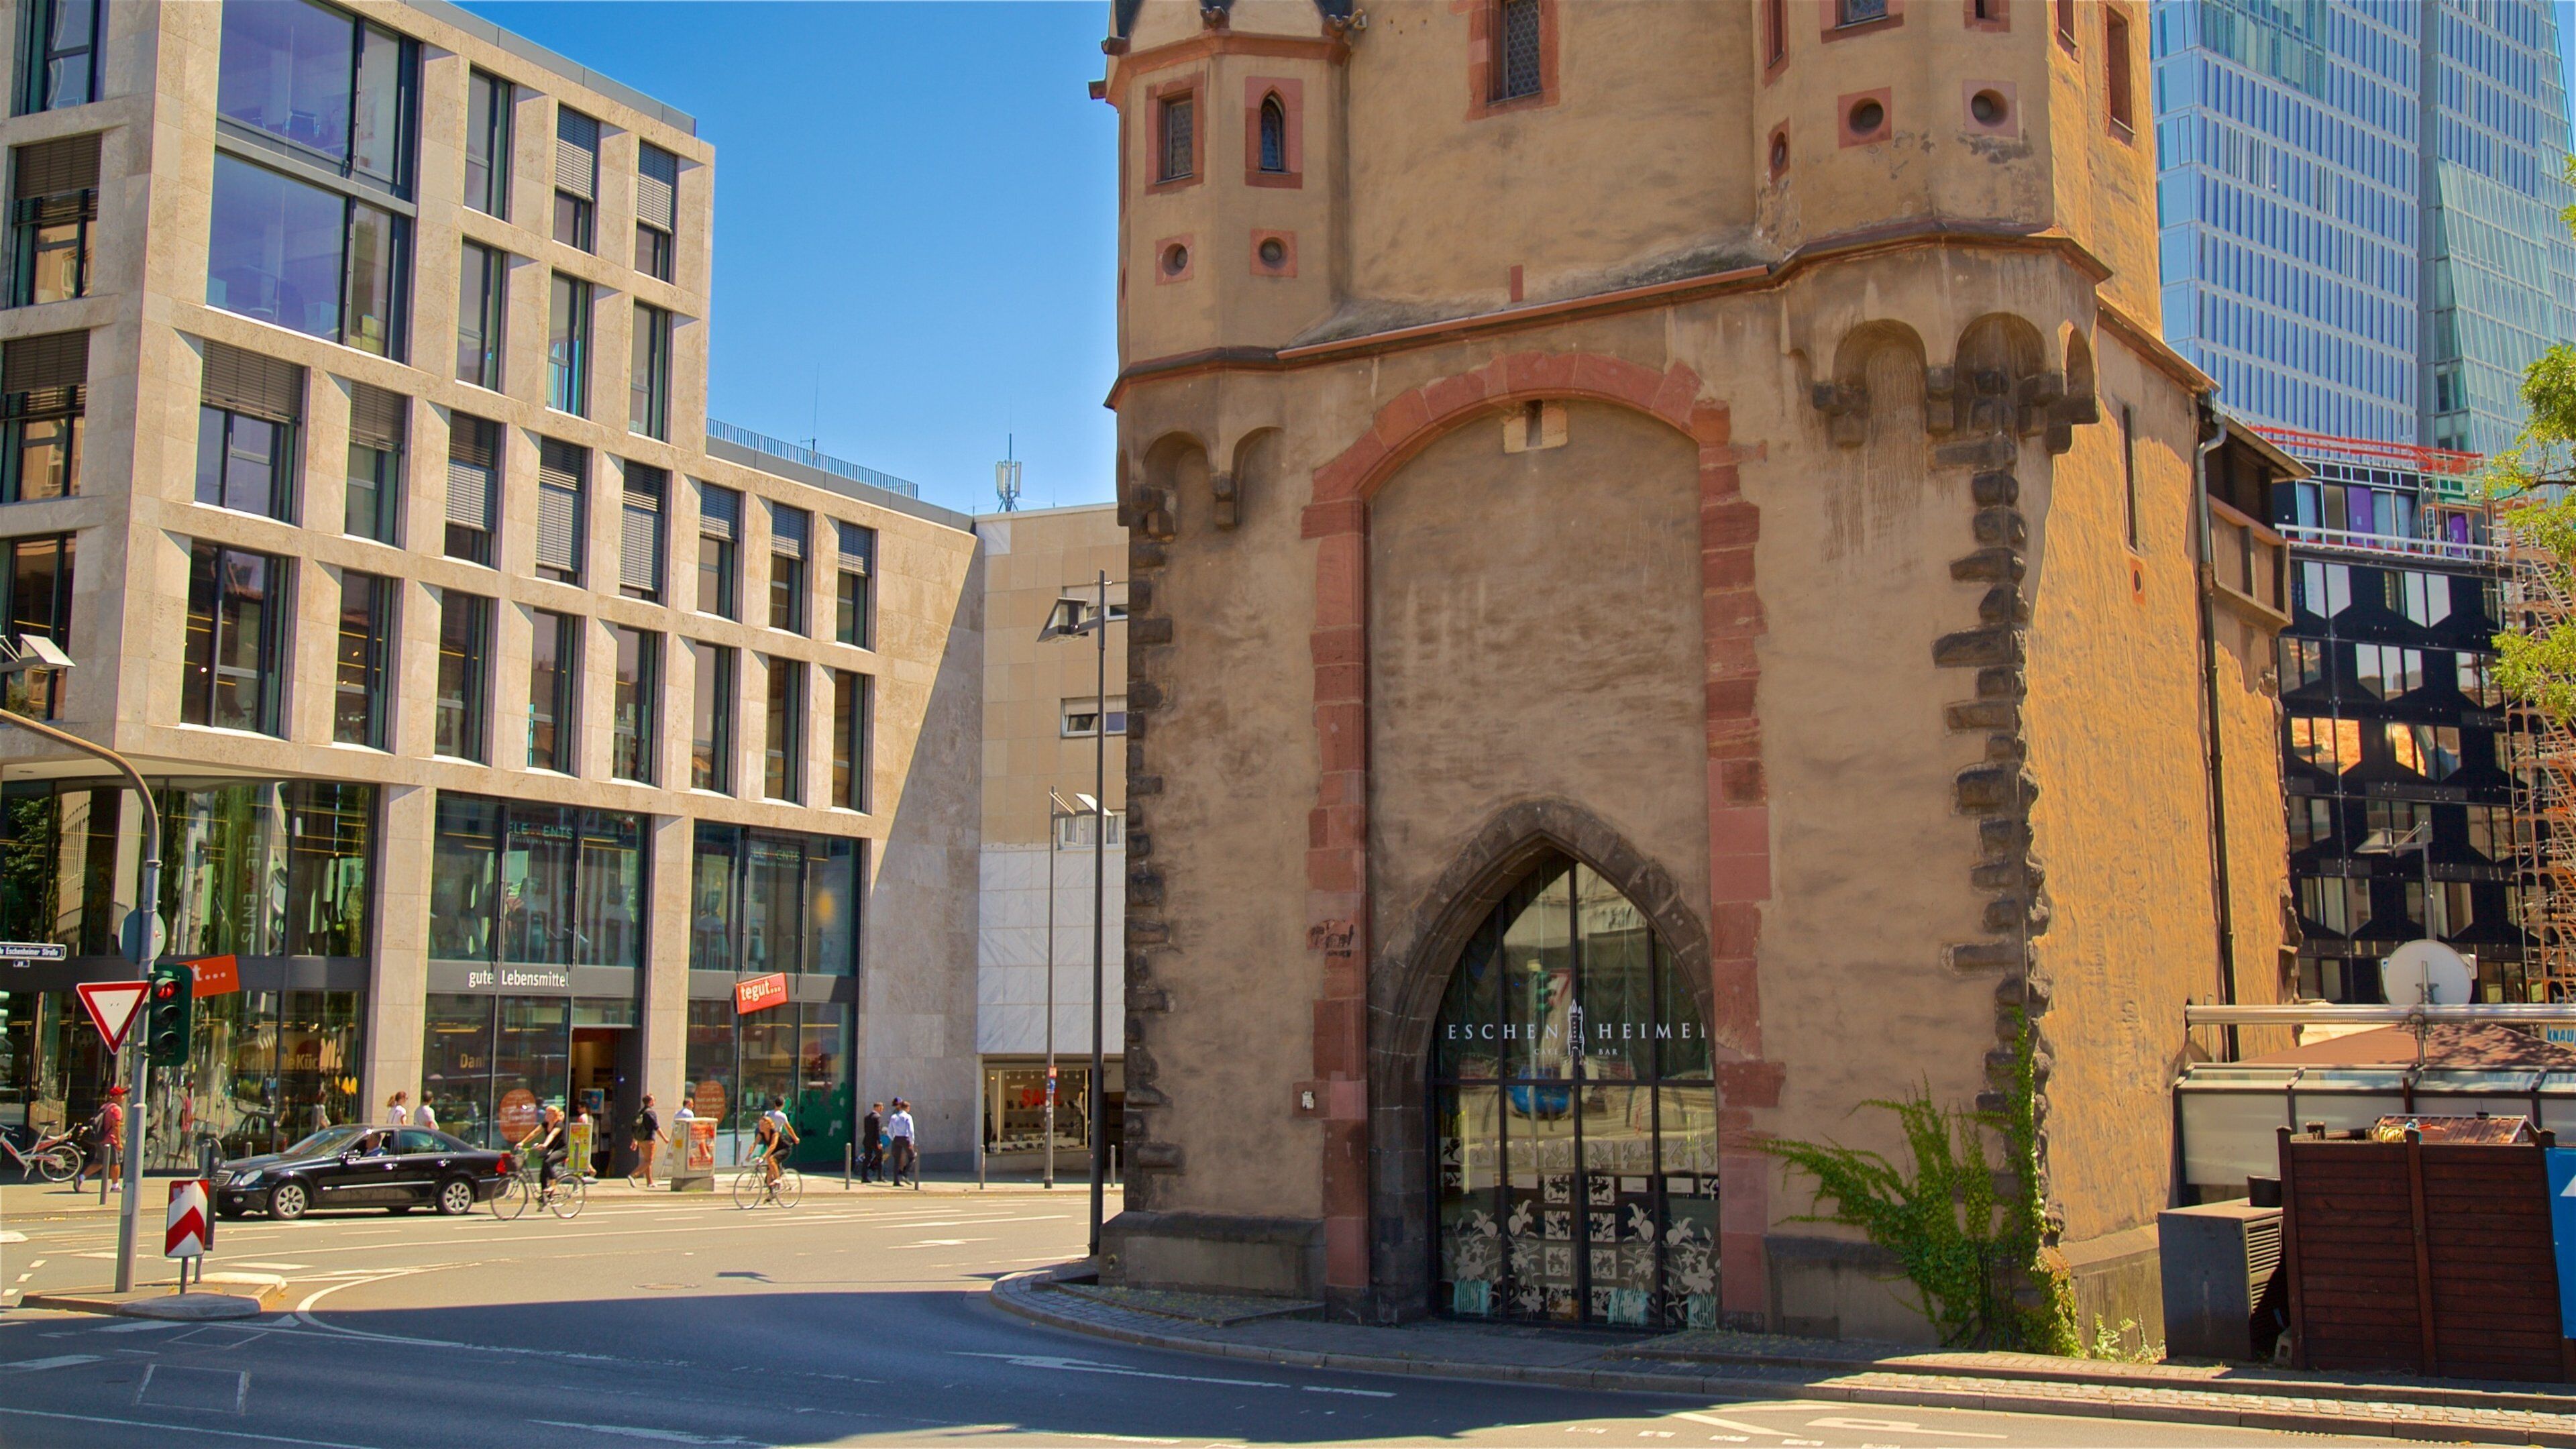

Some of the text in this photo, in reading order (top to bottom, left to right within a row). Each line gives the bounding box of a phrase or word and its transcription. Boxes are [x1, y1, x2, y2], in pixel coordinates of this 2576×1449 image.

[468, 969, 570, 988] gute Lebensmittel
[740, 979, 782, 1002] tegut...
[1448, 1023, 1558, 1040] ESCHEN
[2546, 1023, 2576, 1043] KNAU
[1598, 1048, 1618, 1056] BAR
